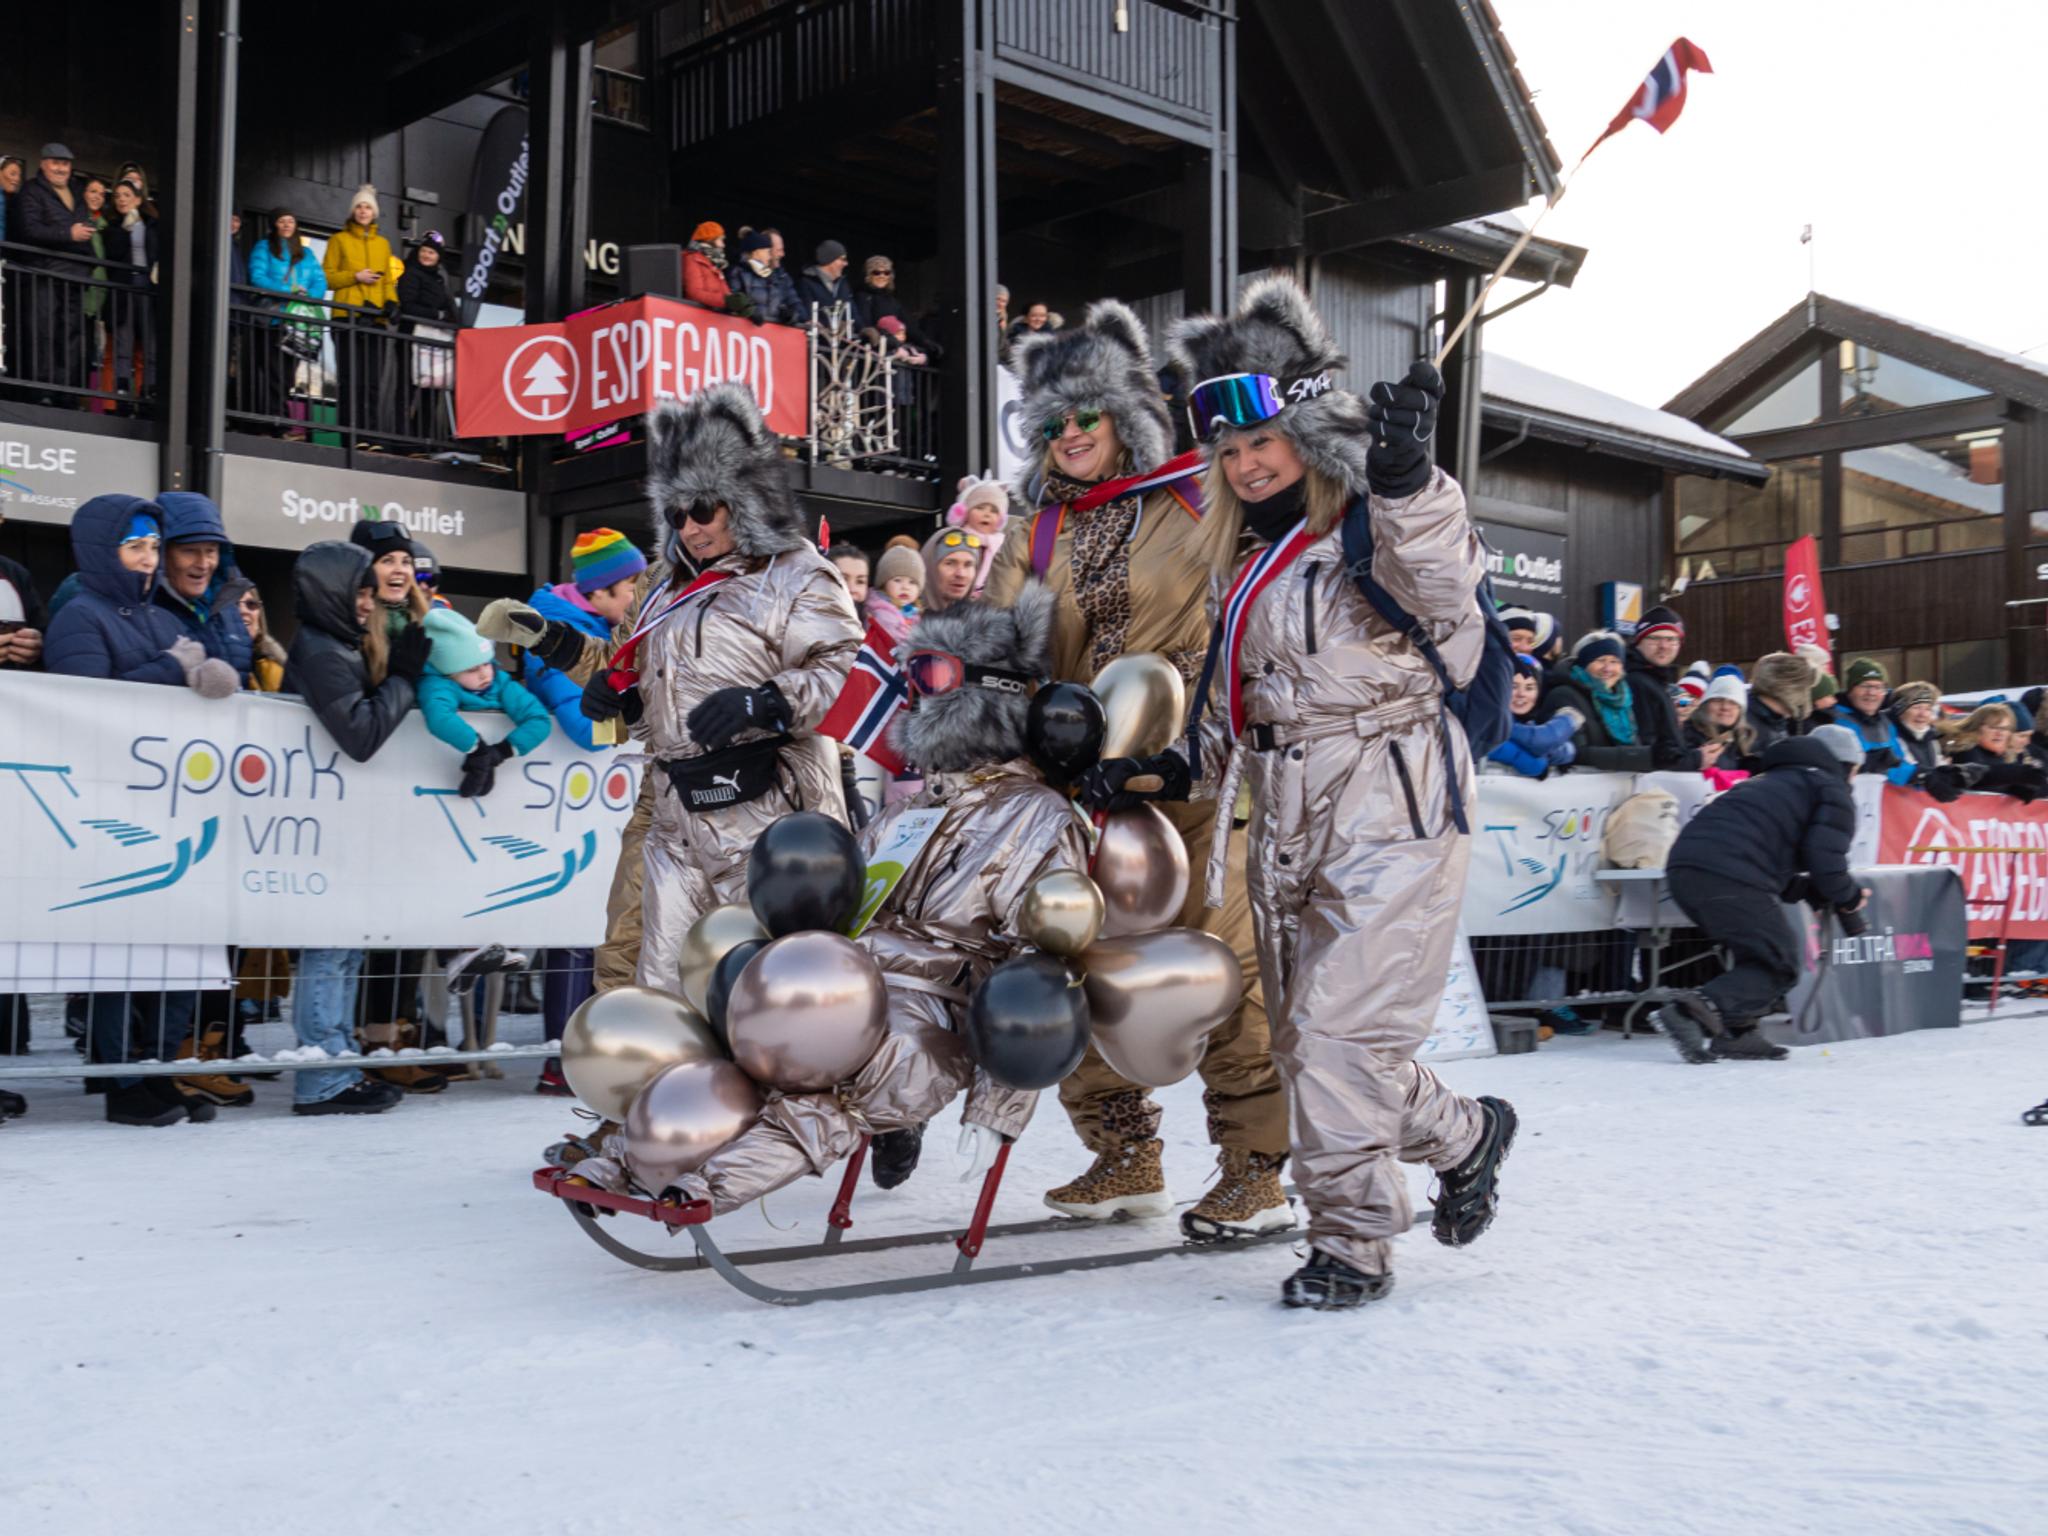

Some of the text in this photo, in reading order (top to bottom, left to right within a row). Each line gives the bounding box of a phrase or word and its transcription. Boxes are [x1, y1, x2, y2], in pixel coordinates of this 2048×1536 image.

[465, 226, 501, 298] Sport
[591, 317, 773, 417] ESPEGARD
[0, 440, 77, 475] ELSE
[281, 489, 464, 536] Sport Outlet
[126, 725, 344, 818] spark
[691, 785, 736, 805] PUMA
[523, 761, 636, 832] spa
[242, 815, 321, 856] vm
[242, 869, 329, 896] GEILO
